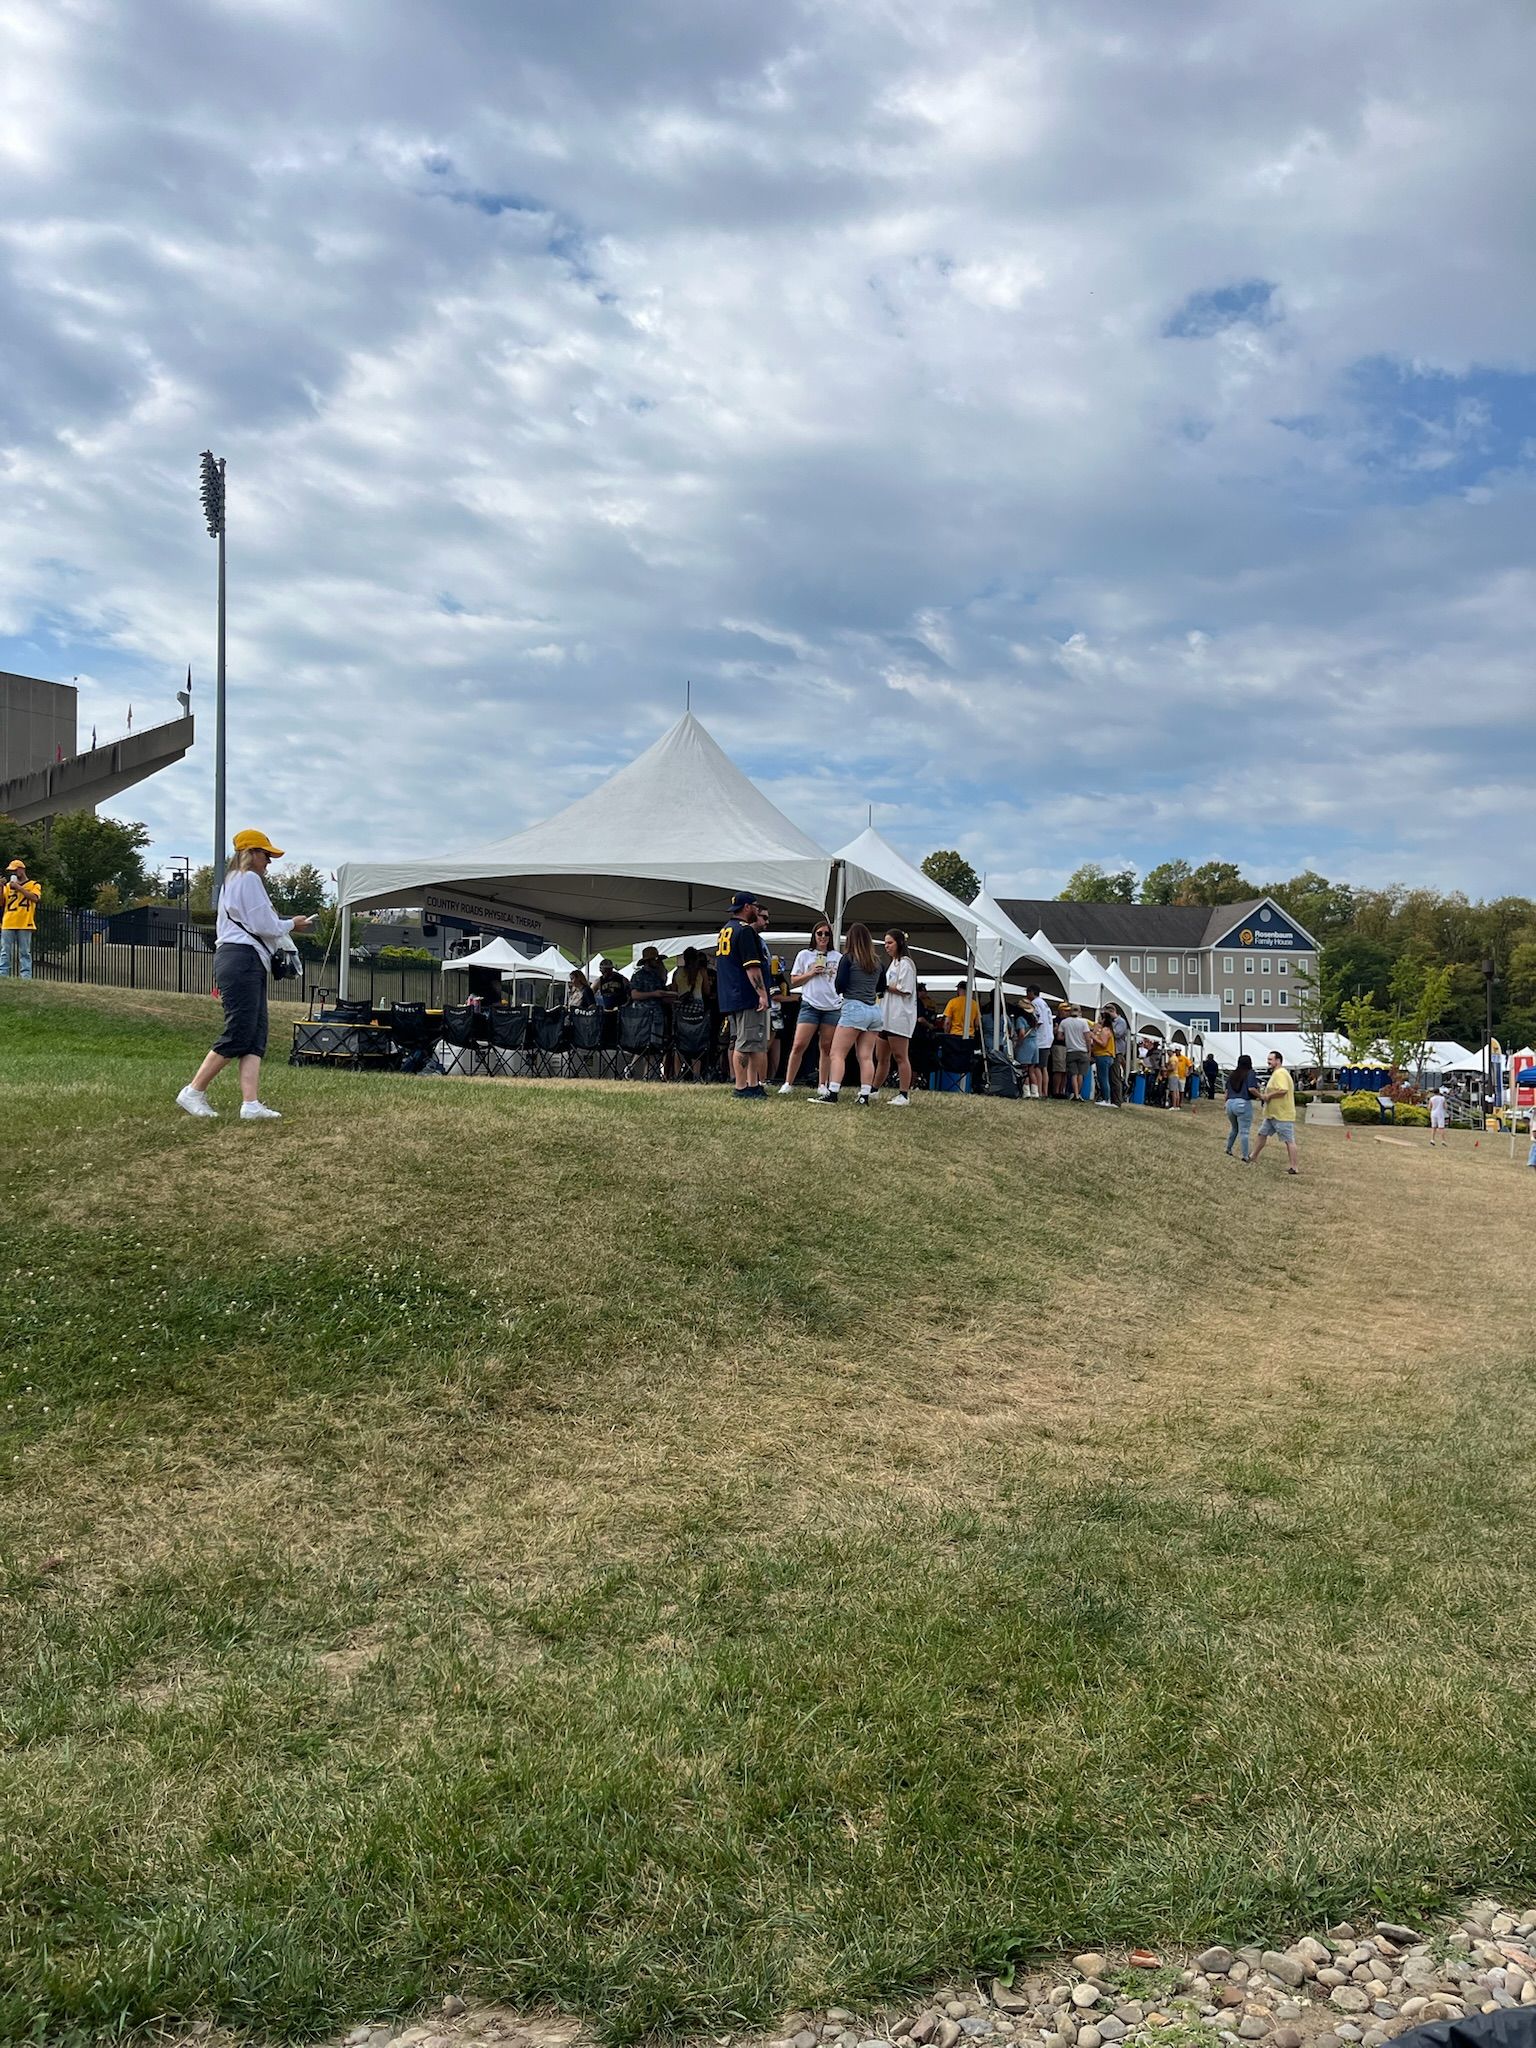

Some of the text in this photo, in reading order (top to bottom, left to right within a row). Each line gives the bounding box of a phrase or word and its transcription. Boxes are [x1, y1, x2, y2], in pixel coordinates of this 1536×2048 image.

[8, 894, 29, 911] 24
[427, 896, 460, 911] COUNTRY
[461, 903, 483, 916] ROADS
[484, 909, 515, 924] PHYSICAL
[515, 916, 542, 929] THERAPY
[1254, 930, 1293, 939] Rosenbaum
[1254, 938, 1293, 946] Family House
